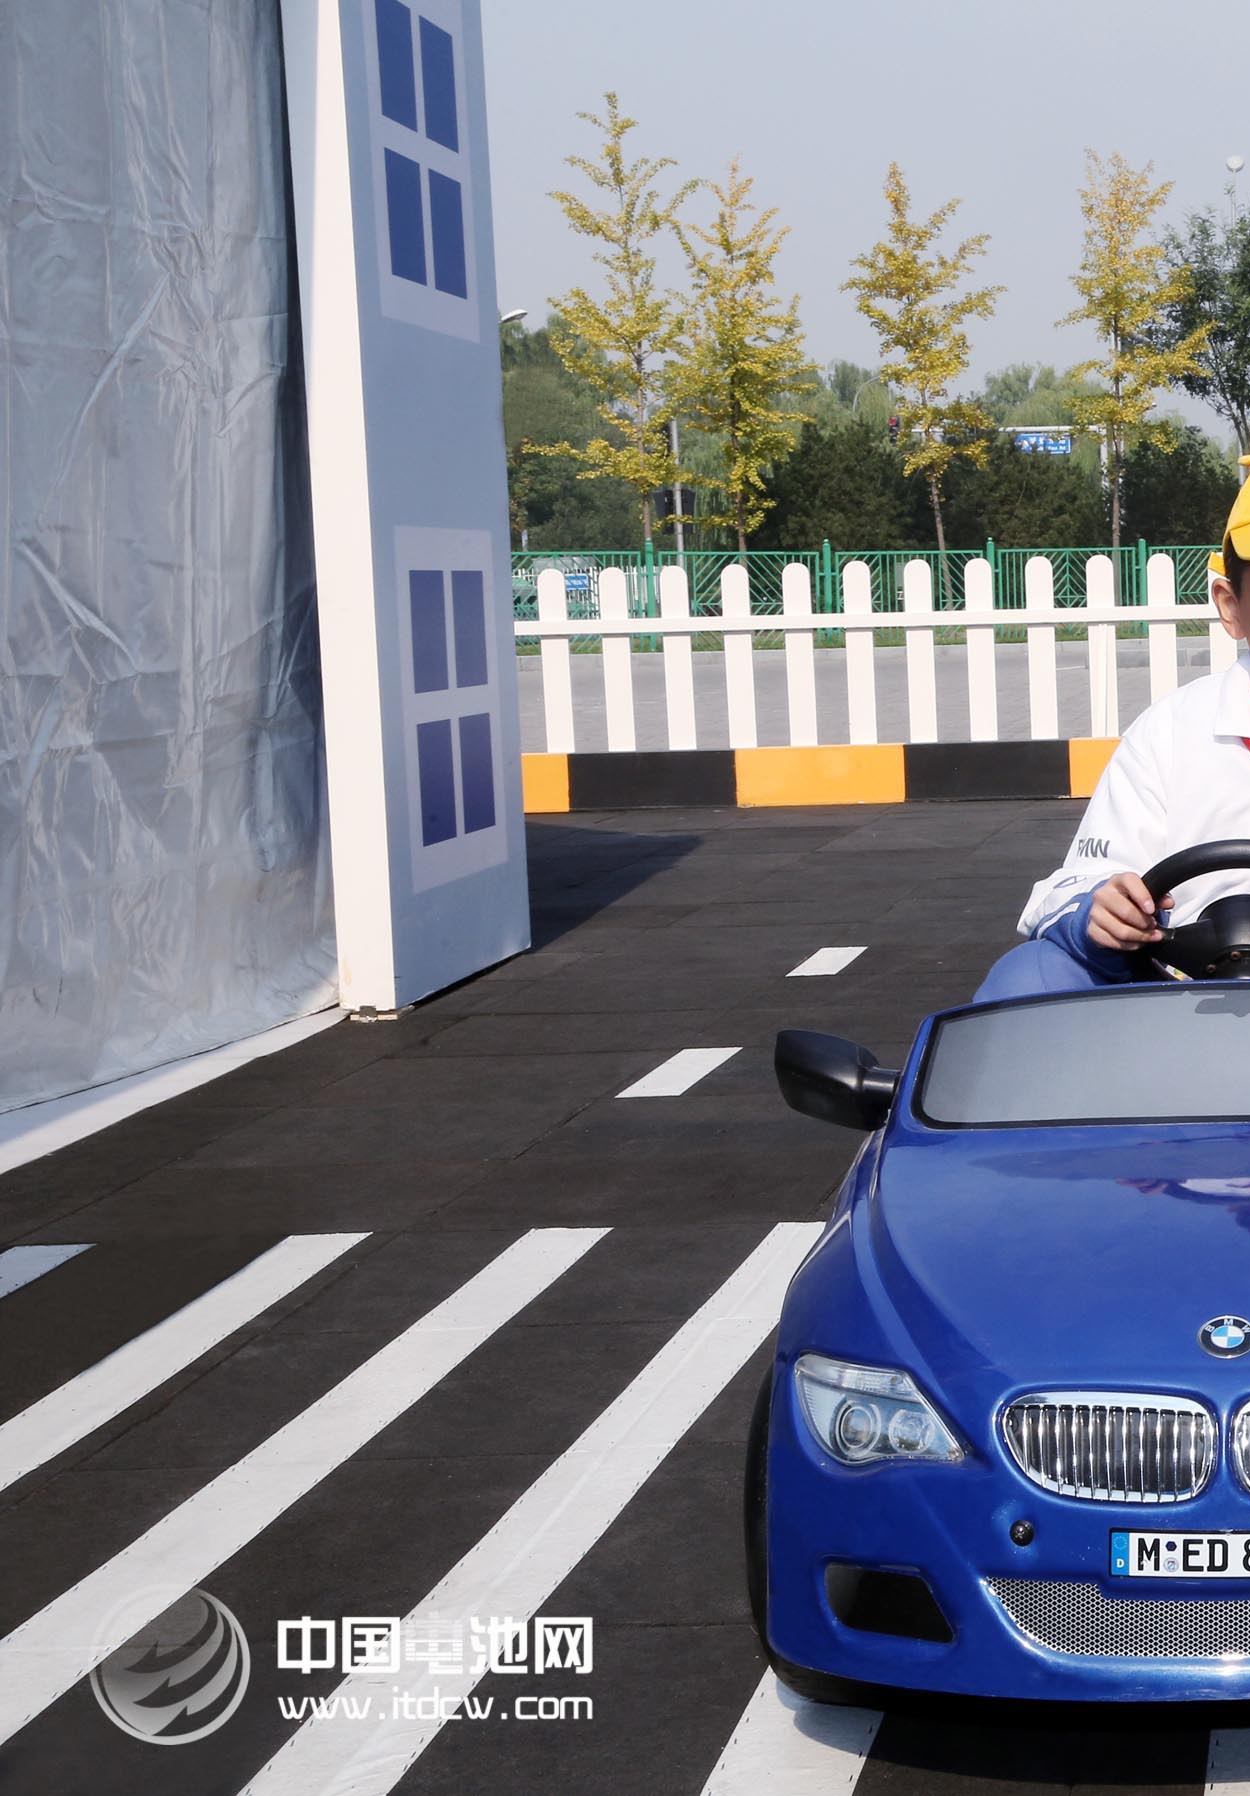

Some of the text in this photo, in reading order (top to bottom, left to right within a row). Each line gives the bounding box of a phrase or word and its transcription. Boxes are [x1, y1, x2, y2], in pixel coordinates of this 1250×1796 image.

[1115, 1558, 1125, 1569] D
[1137, 1537, 1161, 1571] M
[1182, 1538, 1229, 1573] ED
